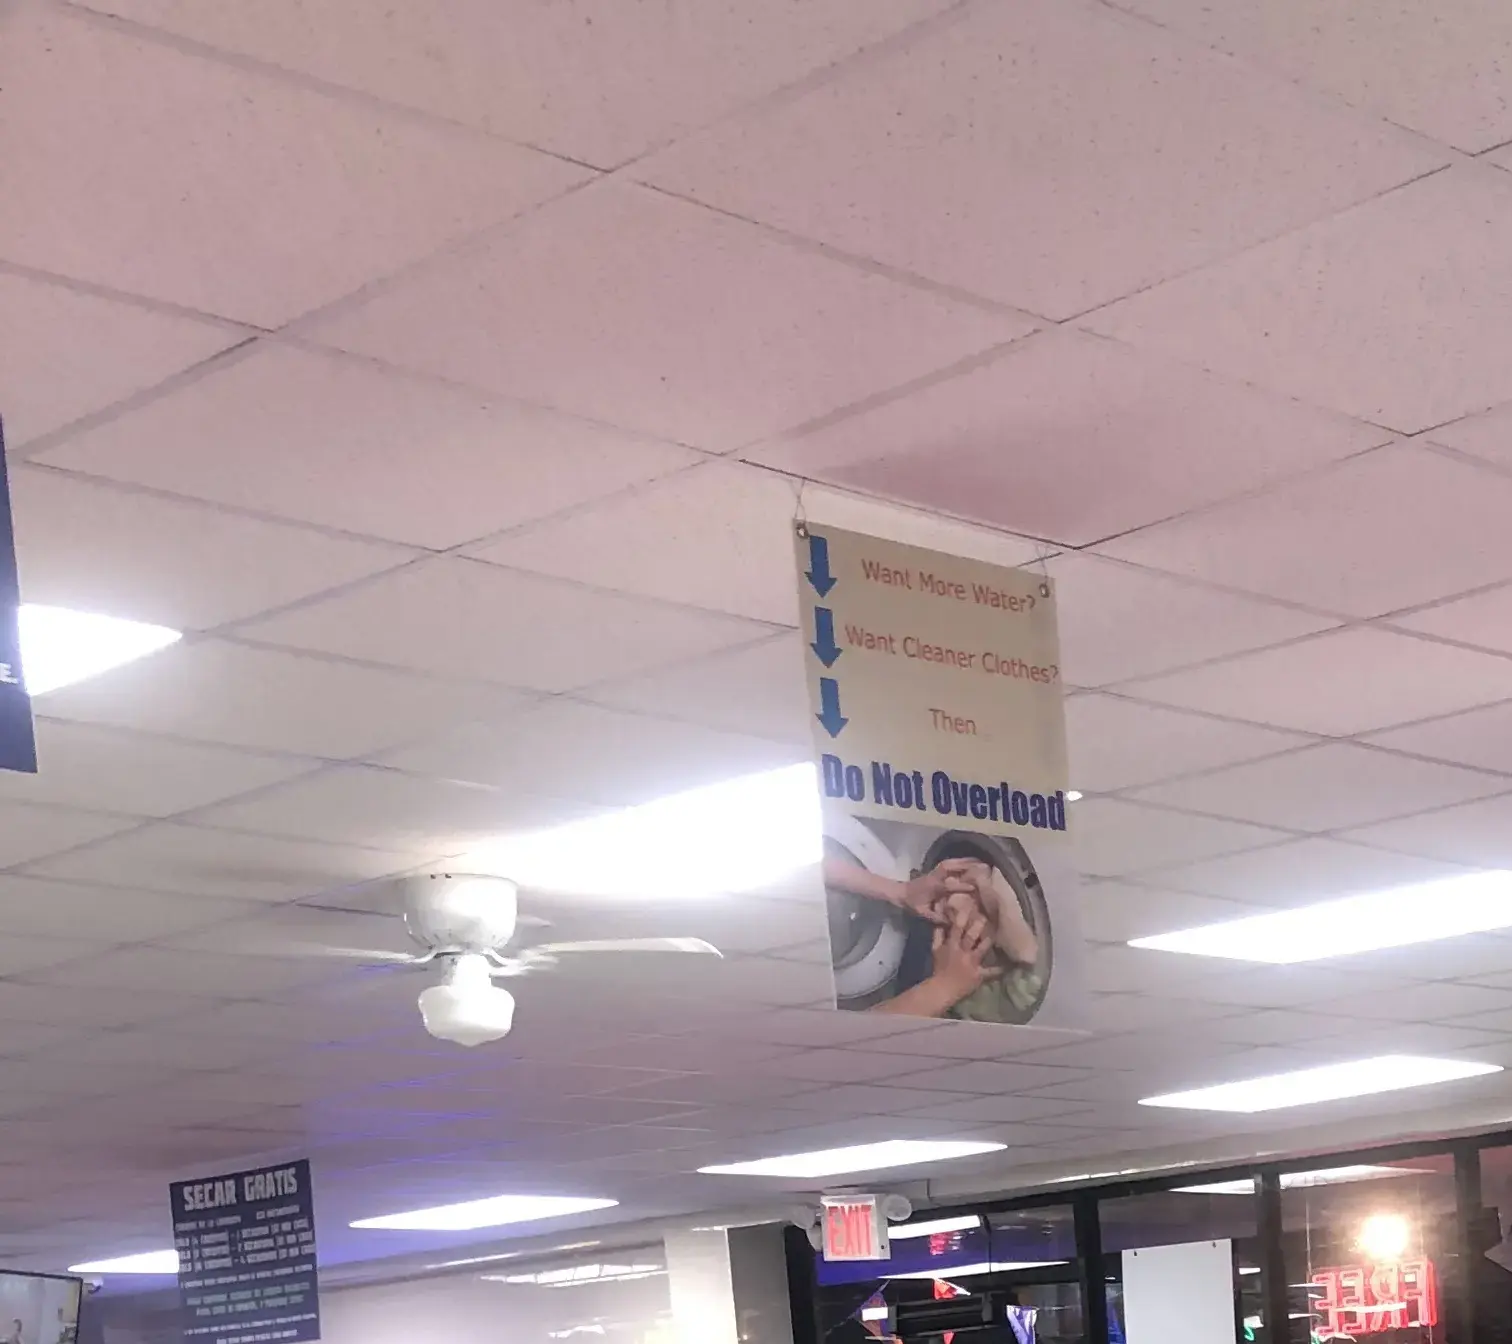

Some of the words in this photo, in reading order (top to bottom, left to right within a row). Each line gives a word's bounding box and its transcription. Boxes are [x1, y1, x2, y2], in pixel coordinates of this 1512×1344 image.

[861, 559, 910, 587] Want
[919, 571, 965, 596] More
[973, 582, 1035, 613] Water?
[845, 625, 896, 655] Want
[903, 636, 975, 669] Cleaner
[982, 652, 1058, 684] Clothes?
[822, 754, 863, 801] Do
[872, 762, 924, 811] Not
[932, 771, 1065, 831] Overload
[183, 1180, 237, 1211] SECAR
[244, 1167, 297, 1201] GRATIS
[829, 1205, 872, 1256] EXIT
